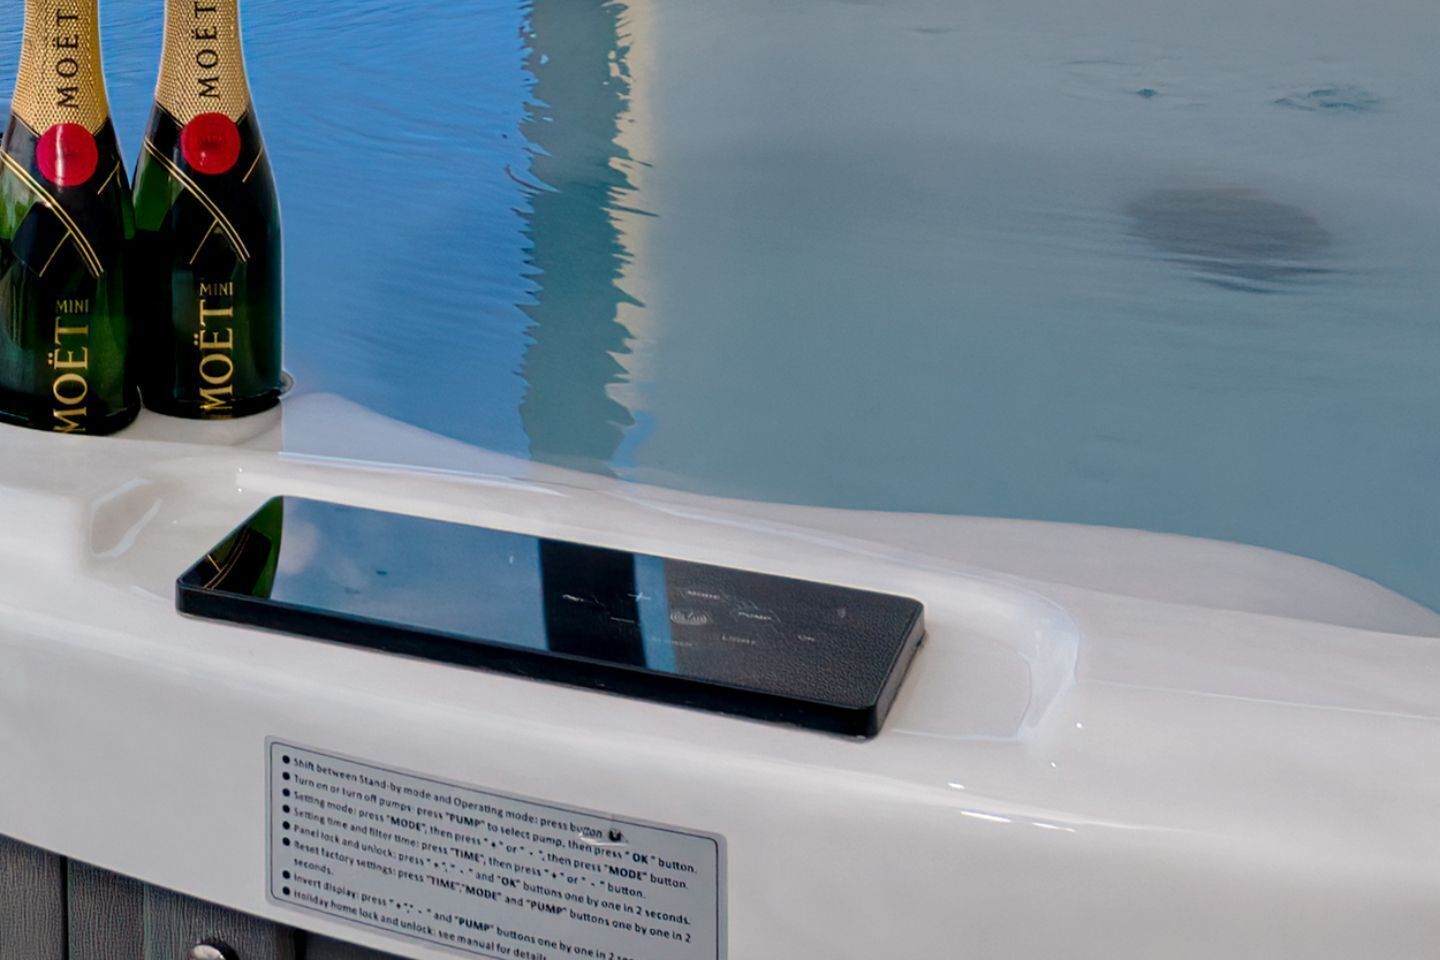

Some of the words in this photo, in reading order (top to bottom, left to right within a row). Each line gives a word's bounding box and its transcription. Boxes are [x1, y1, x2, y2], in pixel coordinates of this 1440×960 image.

[52, 9, 79, 109] MOËT
[191, 0, 220, 99] MOËT
[56, 299, 89, 314] MINI
[199, 281, 234, 297] MINI
[47, 316, 89, 433] MOËT
[194, 299, 234, 410] MOËT
[294, 757, 314, 770] Shift
[316, 763, 357, 781] between
[403, 787, 431, 799] mode
[433, 794, 452, 804] and
[454, 797, 503, 818] Operating
[540, 819, 567, 830] press
[294, 774, 314, 787] Turn
[316, 782, 328, 790] on
[330, 785, 340, 794] or
[342, 786, 362, 799] turn
[364, 793, 377, 803] off
[416, 807, 443, 819] press
[487, 821, 498, 832] to
[500, 827, 530, 839] select
[568, 839, 592, 852] then
[594, 847, 622, 859] press
[294, 790, 325, 808] Setting
[358, 809, 384, 821] press
[430, 825, 453, 838] then
[455, 833, 481, 845] press
[506, 845, 517, 853] or
[547, 852, 571, 865] then
[574, 860, 602, 871] press
[294, 807, 325, 825] Setting
[327, 815, 347, 829] time
[350, 824, 367, 834] and
[369, 826, 392, 840] filter
[421, 842, 448, 854] press
[488, 855, 512, 869] then
[514, 864, 542, 875] press
[567, 875, 578, 884] or
[294, 823, 319, 838] Panel
[321, 830, 339, 843] lock
[342, 838, 359, 848] and
[398, 853, 424, 865] press
[475, 871, 494, 881] and
[523, 880, 562, 897] buttons
[564, 892, 584, 902] one
[586, 895, 600, 907] by
[601, 900, 621, 910] one
[624, 902, 633, 912] in
[294, 840, 320, 854] Reset
[321, 847, 354, 866] factory
[398, 869, 424, 881] press
[505, 895, 523, 905] and
[570, 908, 610, 925] buttons
[612, 919, 632, 929] one
[634, 922, 647, 934] by
[649, 927, 670, 937] one
[672, 930, 682, 940] in
[294, 873, 321, 888] Invert
[361, 893, 387, 905] press
[434, 912, 452, 922] and
[496, 925, 536, 942] buttons
[538, 937, 557, 947] one
[559, 940, 572, 952] by
[574, 945, 593, 955] one
[596, 948, 606, 958] in
[294, 889, 329, 908] Holiday
[331, 899, 358, 914] home
[359, 907, 378, 920] lock
[380, 915, 398, 925] and
[438, 929, 456, 939] see
[457, 935, 494, 949] manual
[496, 942, 511, 953] for
